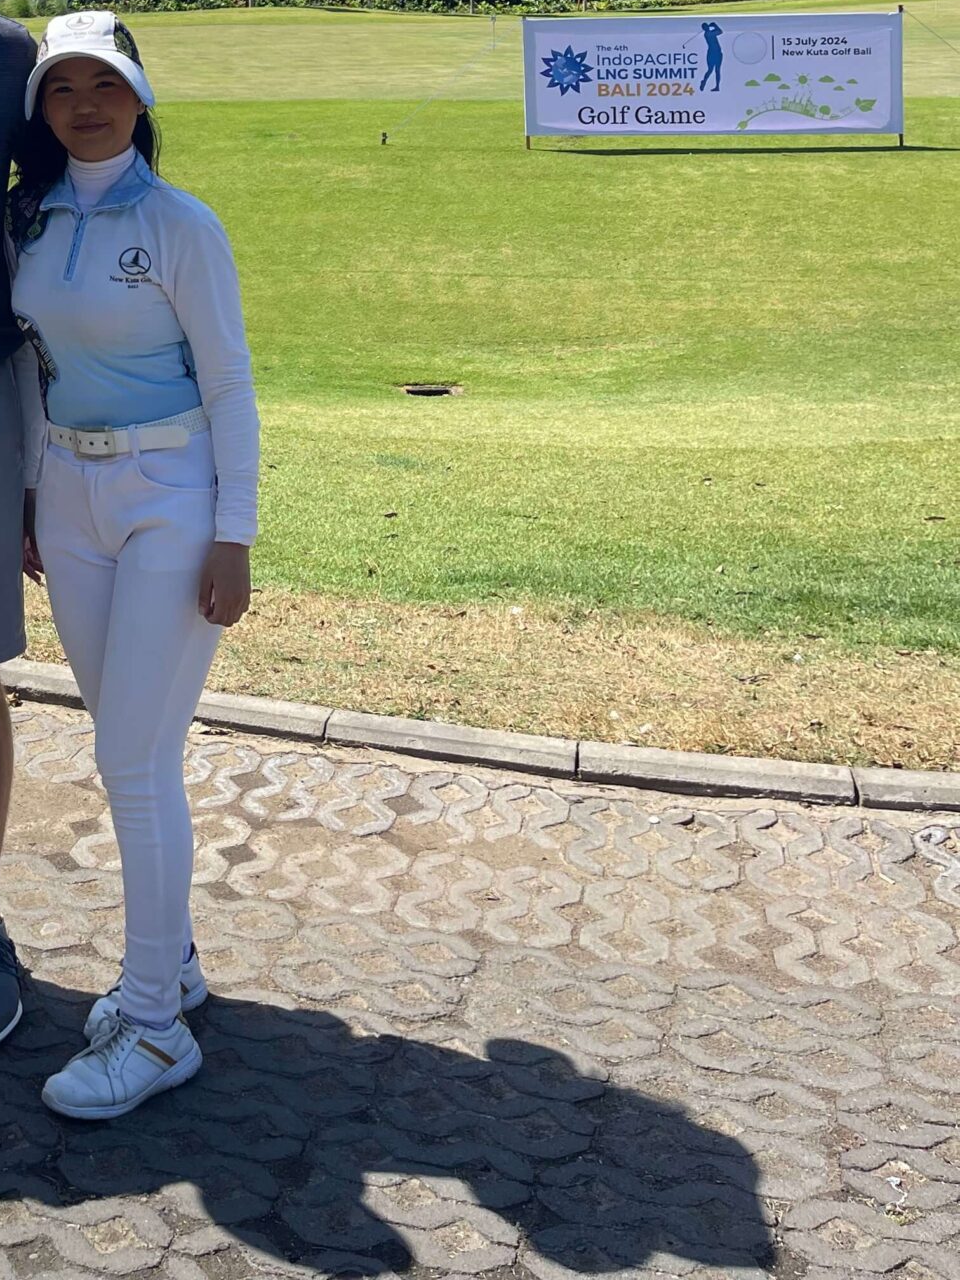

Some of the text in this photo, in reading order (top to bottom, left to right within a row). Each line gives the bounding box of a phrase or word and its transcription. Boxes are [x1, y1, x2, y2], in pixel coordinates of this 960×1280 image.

[781, 36, 848, 47] 15 July 2024
[782, 47, 872, 56] New Kuta Golf Bali
[596, 52, 698, 66] IndoPACIFIC
[596, 67, 698, 80] LNG SUMMIT
[597, 82, 695, 97] BALI 2024
[577, 105, 706, 125] Golf Game
